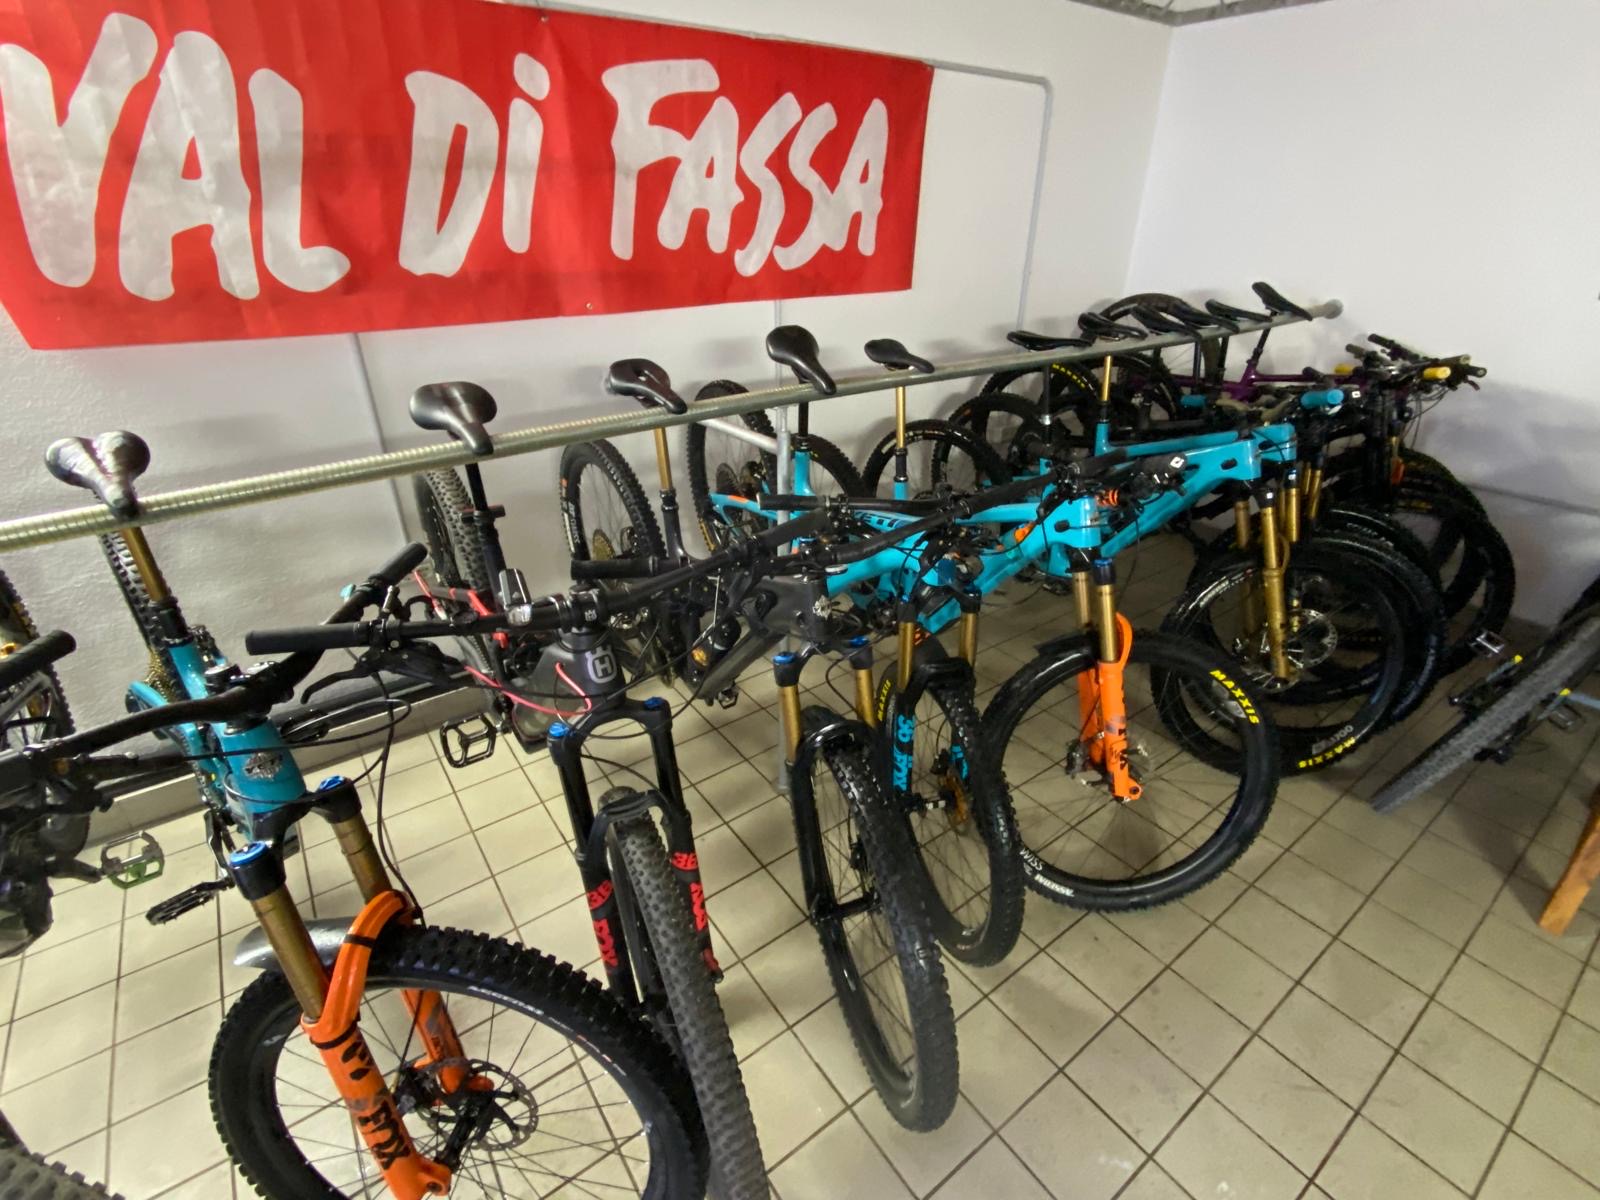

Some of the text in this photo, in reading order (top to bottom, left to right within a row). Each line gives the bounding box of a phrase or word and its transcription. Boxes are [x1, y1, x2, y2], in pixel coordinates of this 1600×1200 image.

[0, 13, 351, 301] VAL
[601, 59, 889, 277] FASSA
[1209, 669, 1260, 724] MAXXIS
[357, 1099, 412, 1170] FOX
